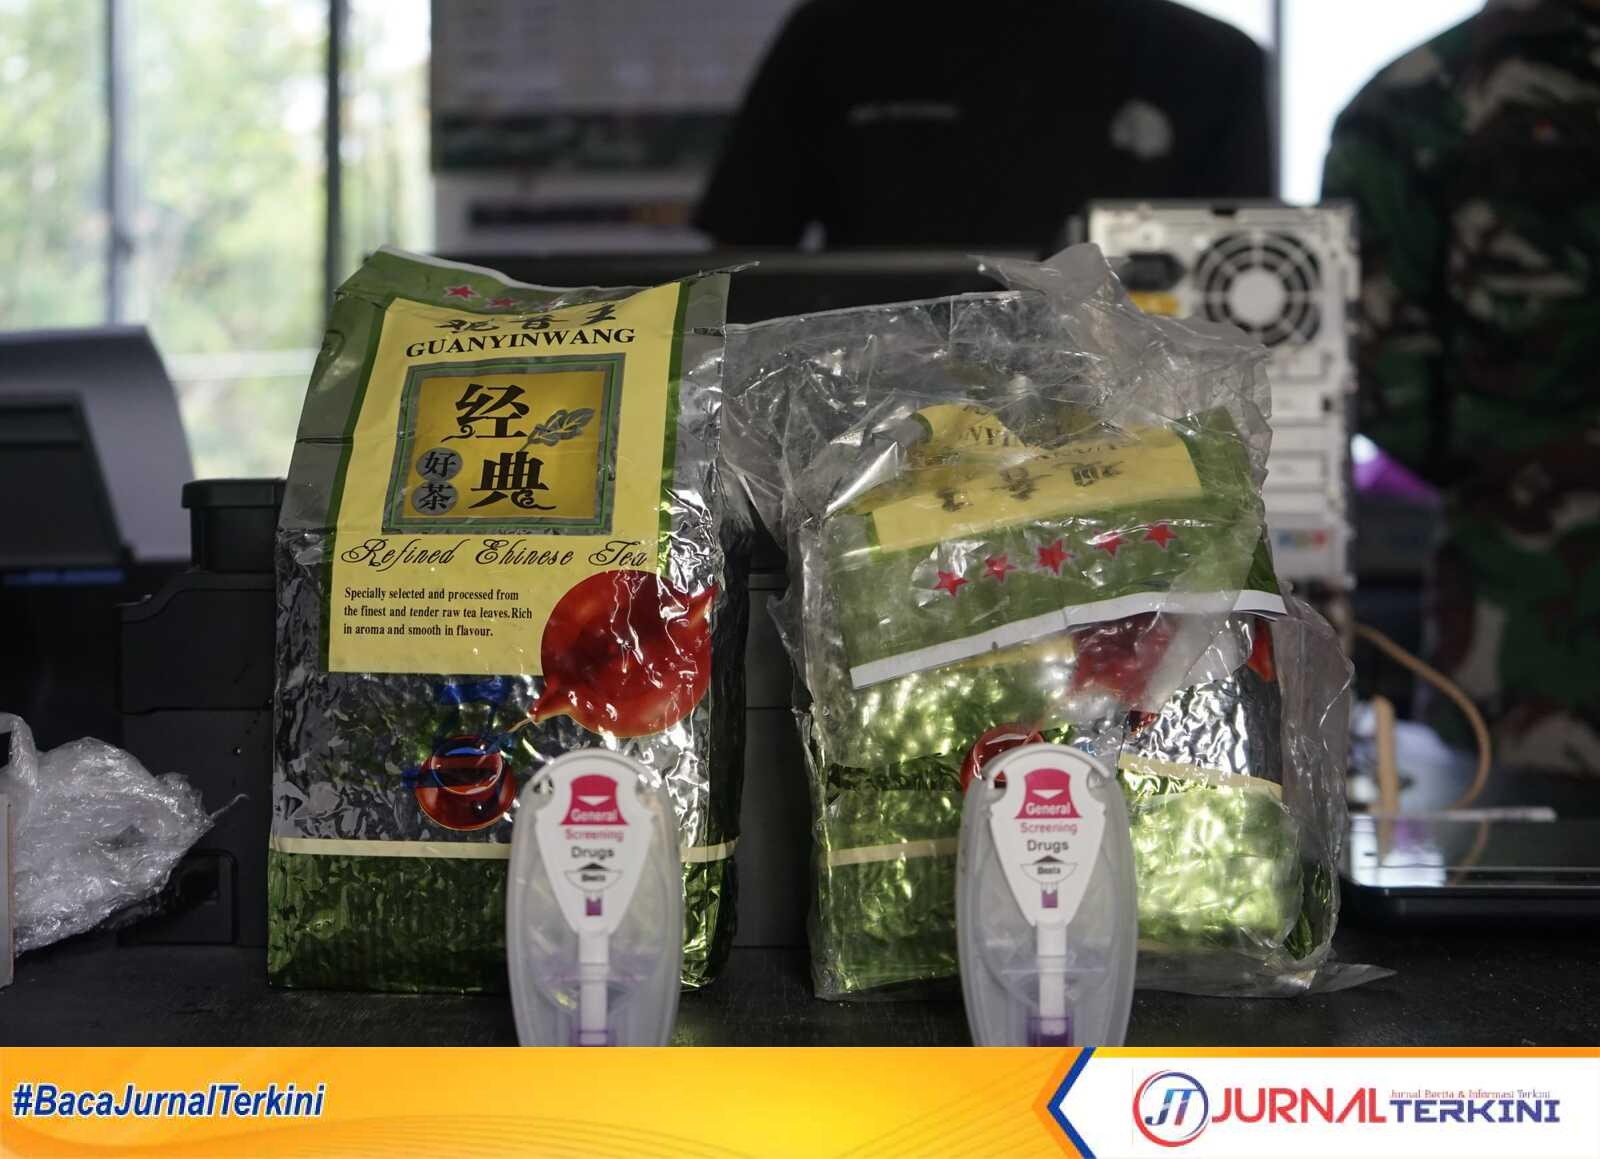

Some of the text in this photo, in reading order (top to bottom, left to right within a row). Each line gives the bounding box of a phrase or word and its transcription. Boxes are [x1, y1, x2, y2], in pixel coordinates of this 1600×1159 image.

[405, 327, 636, 358] GUANYINWANG
[341, 538, 471, 572] Refined
[588, 540, 648, 567] Tea
[344, 587, 519, 602] Specially selected and processed from
[344, 605, 358, 616] the
[361, 605, 386, 617] finest
[389, 606, 406, 617] and
[410, 606, 440, 617] tender
[442, 608, 461, 618] raw
[463, 608, 477, 618] tea
[343, 623, 494, 637] in aroma and smooth in flavour.
[1026, 802, 1071, 816] General
[565, 828, 624, 843] Screening
[1020, 821, 1078, 836] Screening
[571, 846, 614, 861] Drugs
[1027, 839, 1069, 854] Drugs
